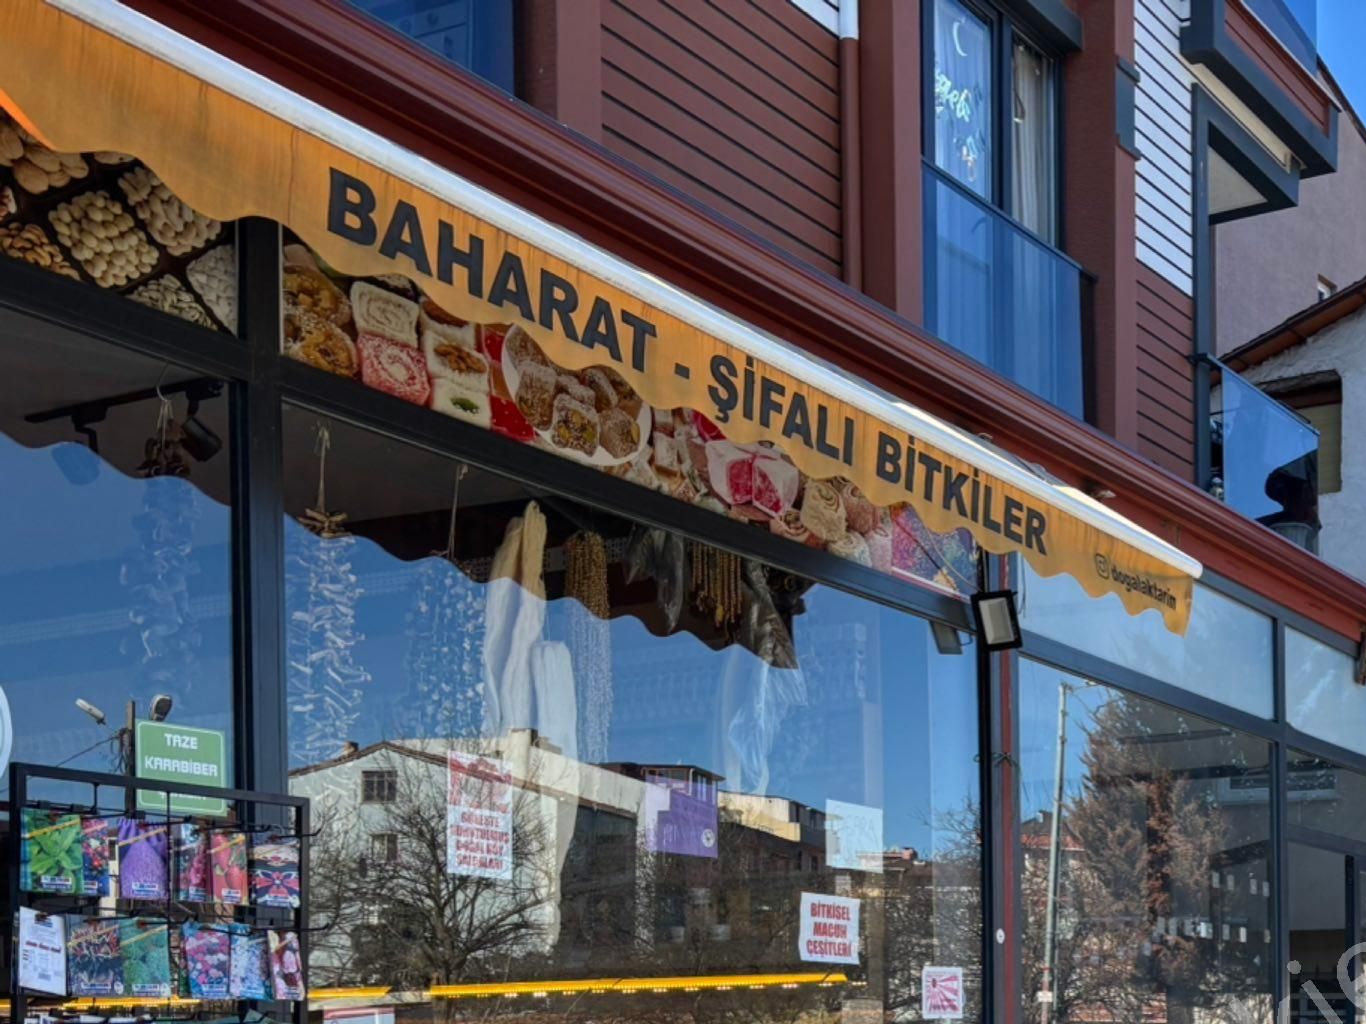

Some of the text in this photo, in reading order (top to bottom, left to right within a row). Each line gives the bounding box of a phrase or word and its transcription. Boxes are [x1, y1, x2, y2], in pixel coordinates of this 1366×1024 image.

[328, 167, 657, 372] BAHARAT
[708, 353, 854, 466] ŞİFALI
[876, 431, 1048, 556] BİTKİLER
[164, 733, 198, 750] TAZE
[145, 756, 218, 777] KARABİBER
[810, 902, 851, 921] BİTKİSEL
